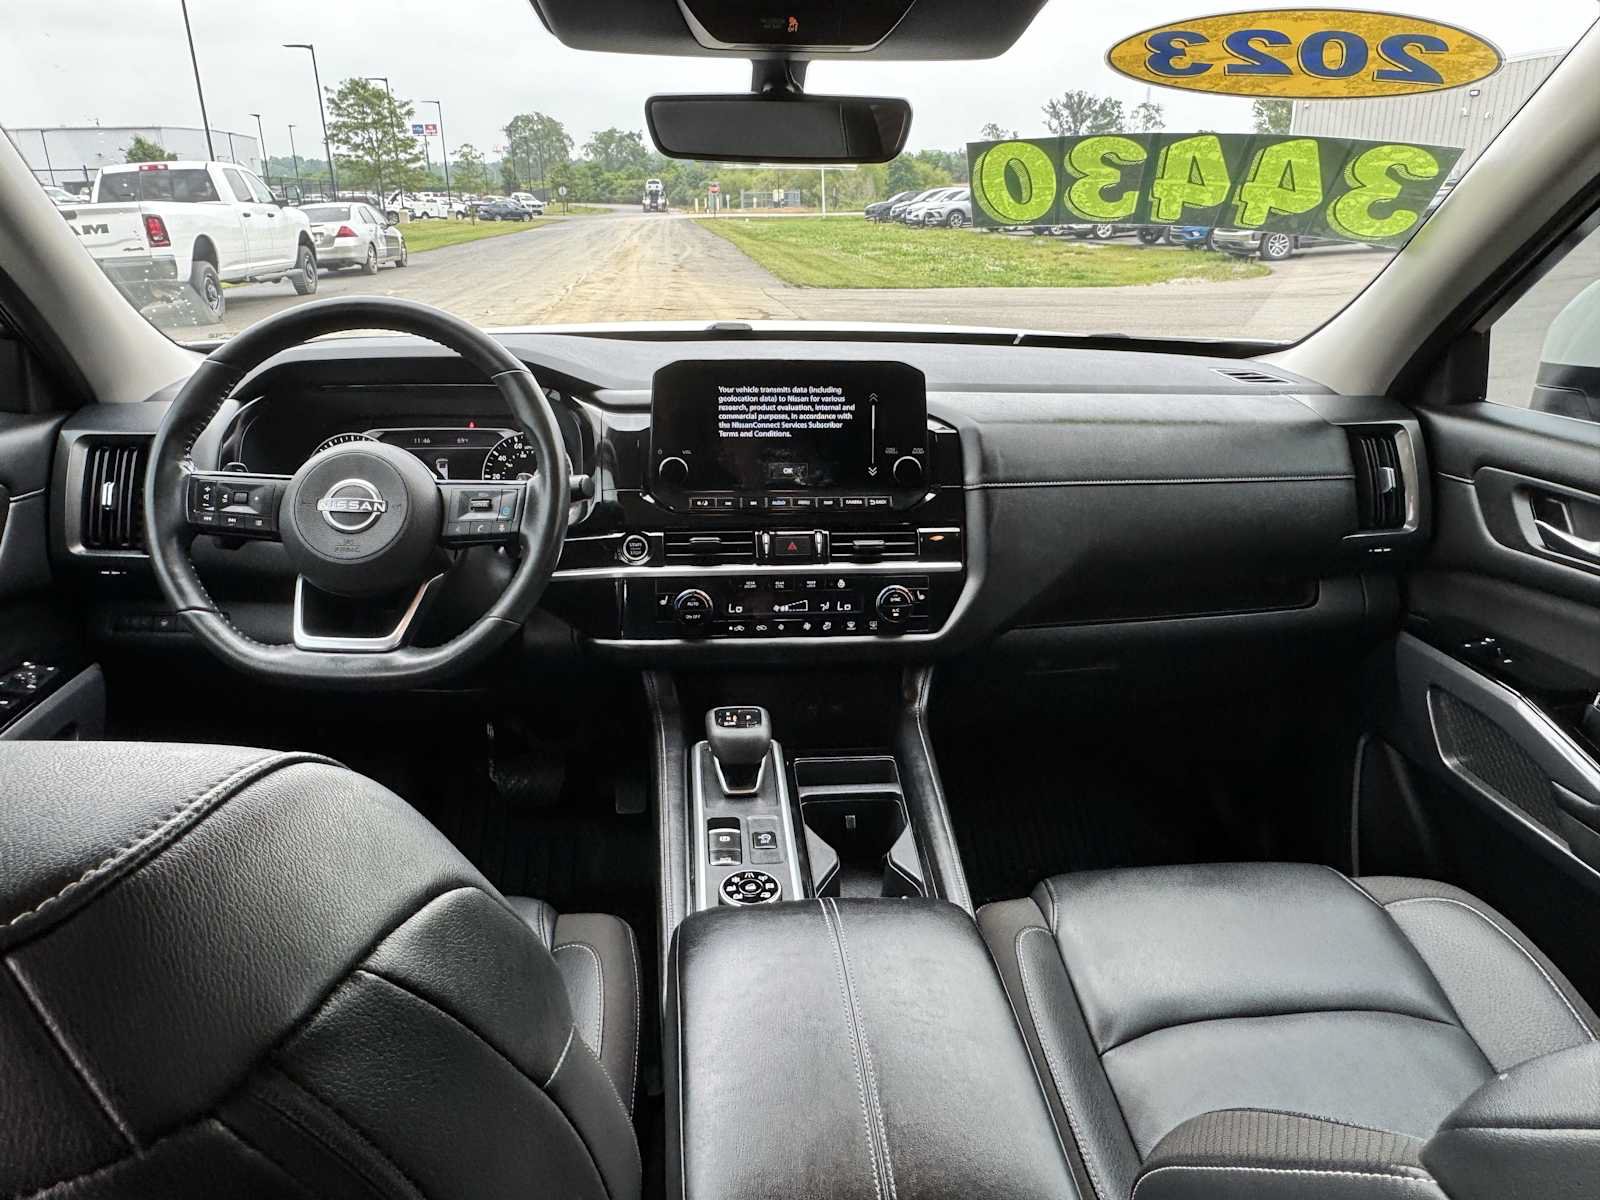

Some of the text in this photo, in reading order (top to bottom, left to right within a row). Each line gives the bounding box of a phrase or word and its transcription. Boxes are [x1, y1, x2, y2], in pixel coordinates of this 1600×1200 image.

[718, 386, 842, 395] Your vehicle transmits data (including
[718, 395, 845, 403] geolocation data) to Nissan for various
[749, 403, 776, 412] product
[776, 403, 814, 412] evaluation,
[814, 403, 841, 411] internal
[842, 403, 855, 411] and
[718, 412, 757, 420] commercial
[790, 412, 798, 420] in
[798, 412, 836, 420] accordance
[836, 412, 853, 420] with
[718, 421, 843, 429] the NissanConnect Services Subscriber
[718, 430, 792, 438] Terms and Conditions.
[317, 499, 387, 513] NISSAN
